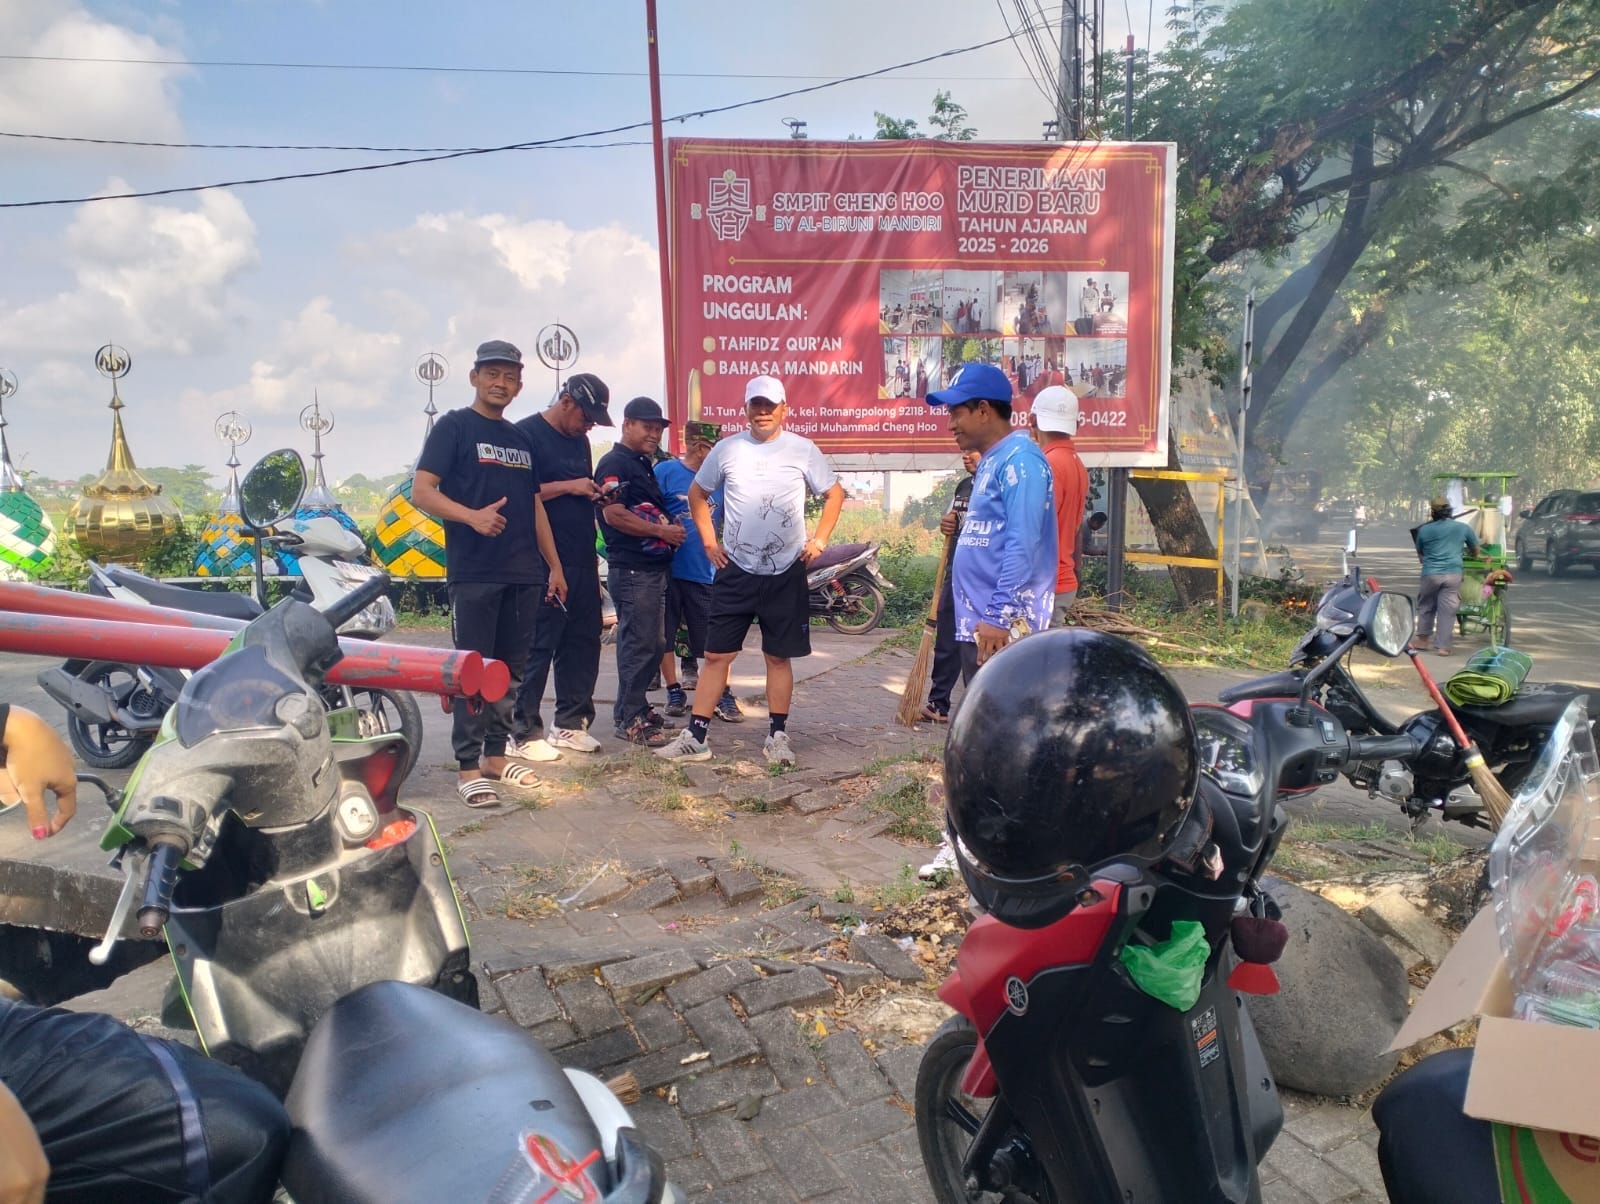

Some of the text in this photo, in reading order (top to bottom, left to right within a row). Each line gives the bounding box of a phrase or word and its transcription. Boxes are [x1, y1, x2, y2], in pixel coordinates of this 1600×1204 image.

[958, 165, 1106, 191] PENERIMAAN
[773, 191, 944, 211] SMPIT CHENG HOO
[957, 190, 1101, 215] MURID BARU
[773, 215, 942, 232] BY AL-BIRUNI MANDIRI
[958, 217, 1087, 234] TAHUN AJARAN
[958, 237, 996, 252] 2025
[1010, 238, 1049, 253] 2026
[703, 274, 792, 294] PROGRAM
[703, 301, 808, 321] UNGGULAN:
[719, 336, 842, 352] TAHFIDZ QUR'AN
[719, 360, 863, 375] BAHASA MANDARIN
[703, 406, 714, 417] Jl.
[717, 406, 737, 417] Tun
[799, 406, 818, 417] kel.
[820, 406, 897, 419] Romangpolong
[785, 423, 818, 435] Masjid
[820, 422, 880, 432] Muhammad
[882, 422, 915, 434] Cheng
[917, 421, 937, 431] Hoo
